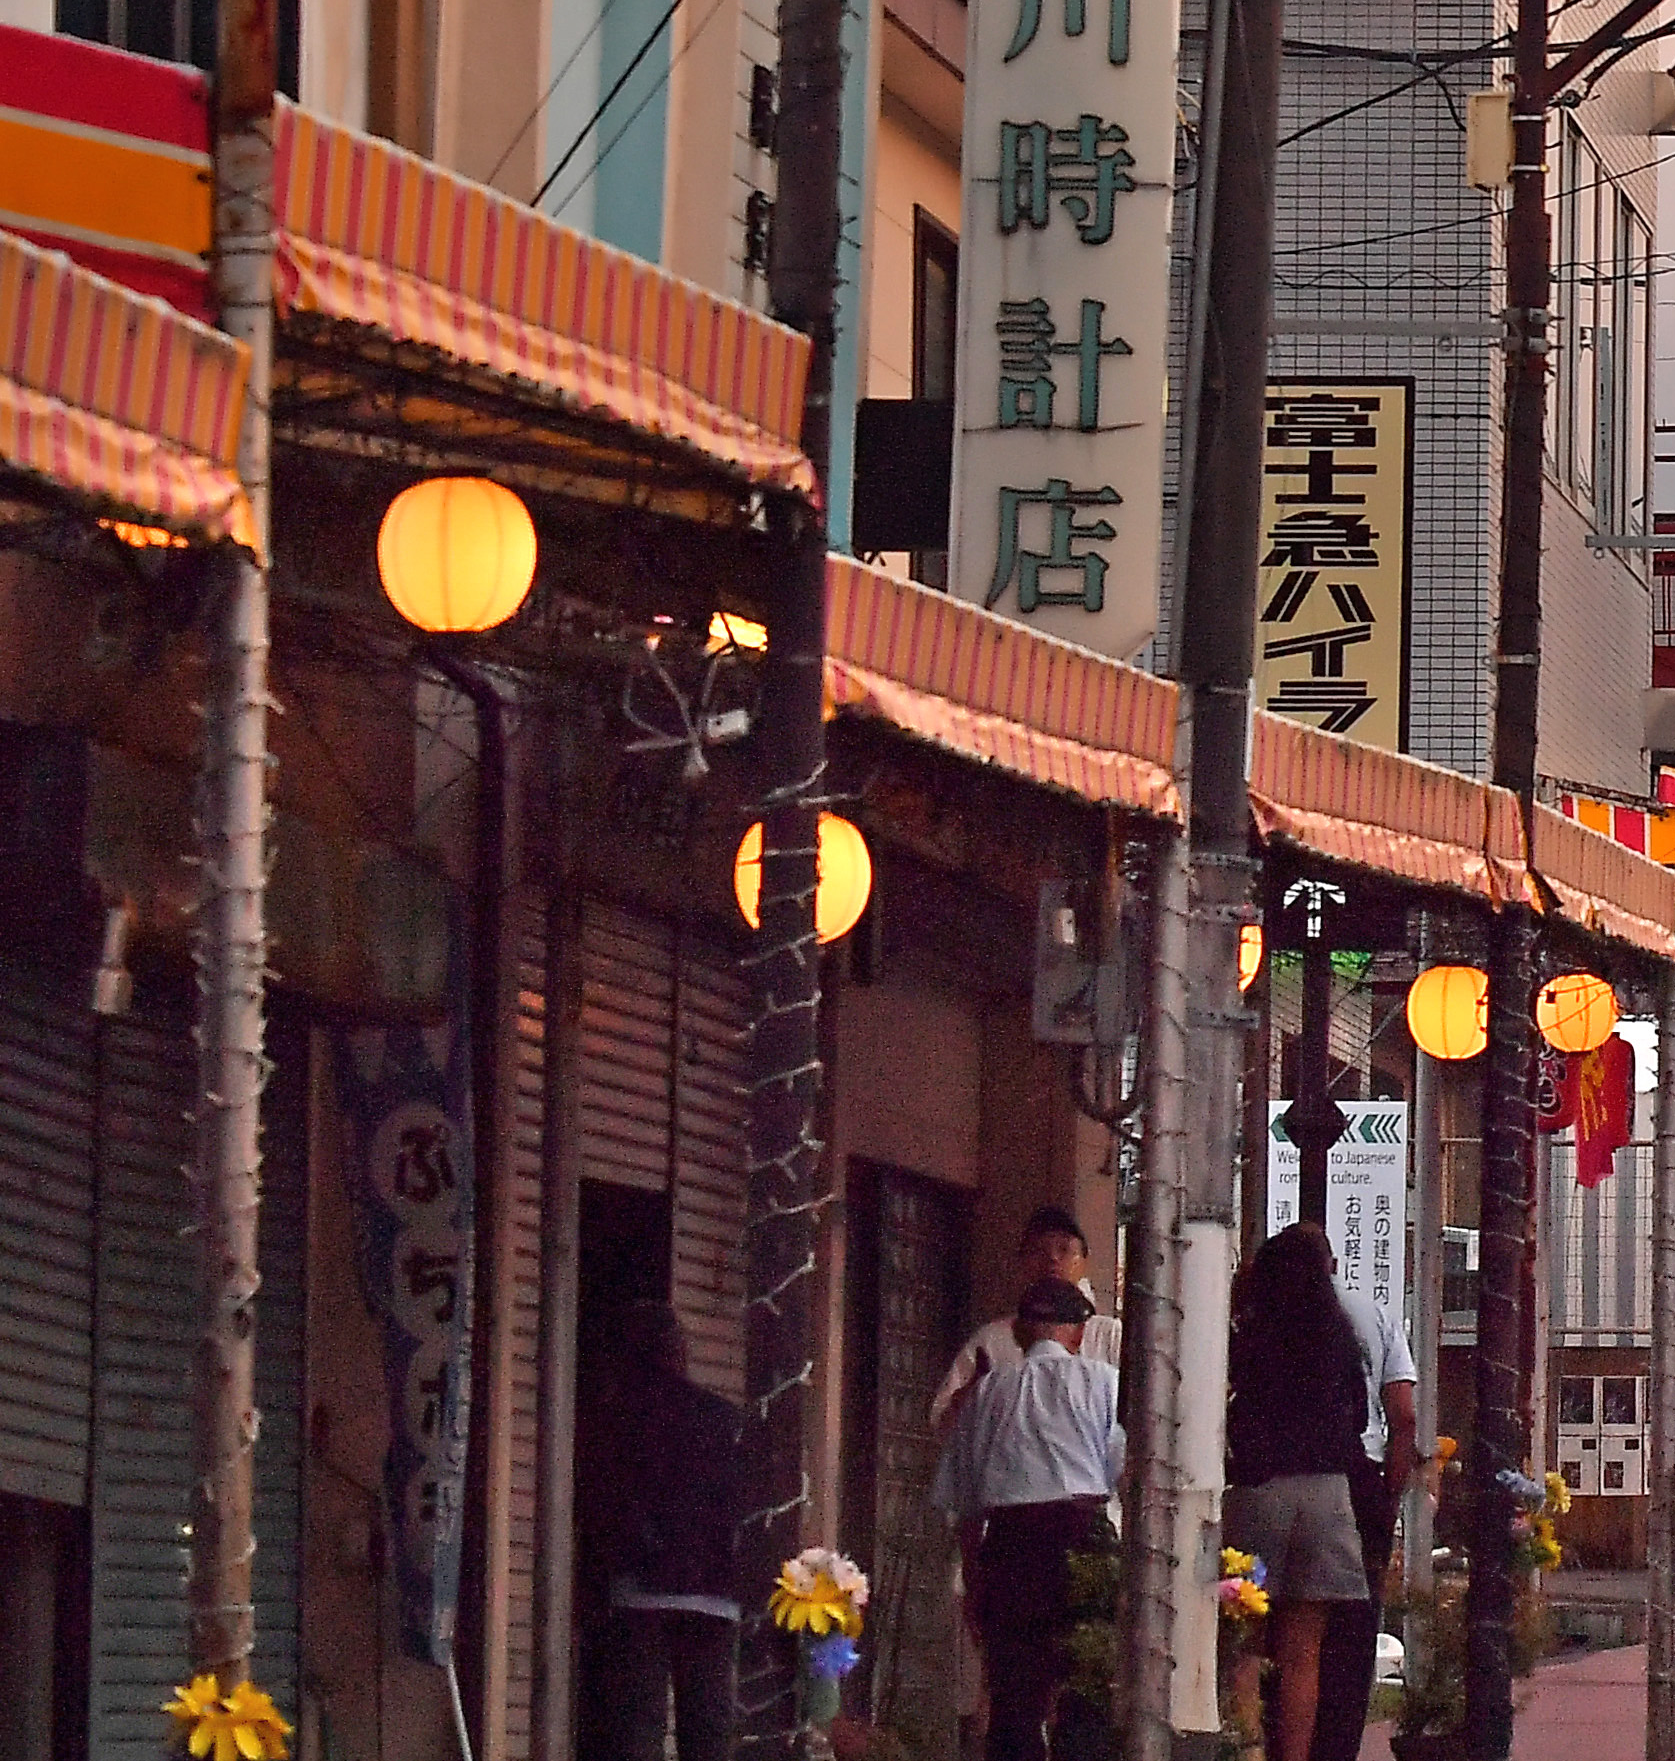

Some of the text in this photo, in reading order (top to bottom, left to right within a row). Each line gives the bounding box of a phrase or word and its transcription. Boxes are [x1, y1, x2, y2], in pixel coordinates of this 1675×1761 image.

[1331, 1151, 1343, 1165] to
[1344, 1151, 1396, 1168] Japanese
[1331, 1170, 1372, 1185] culture.
